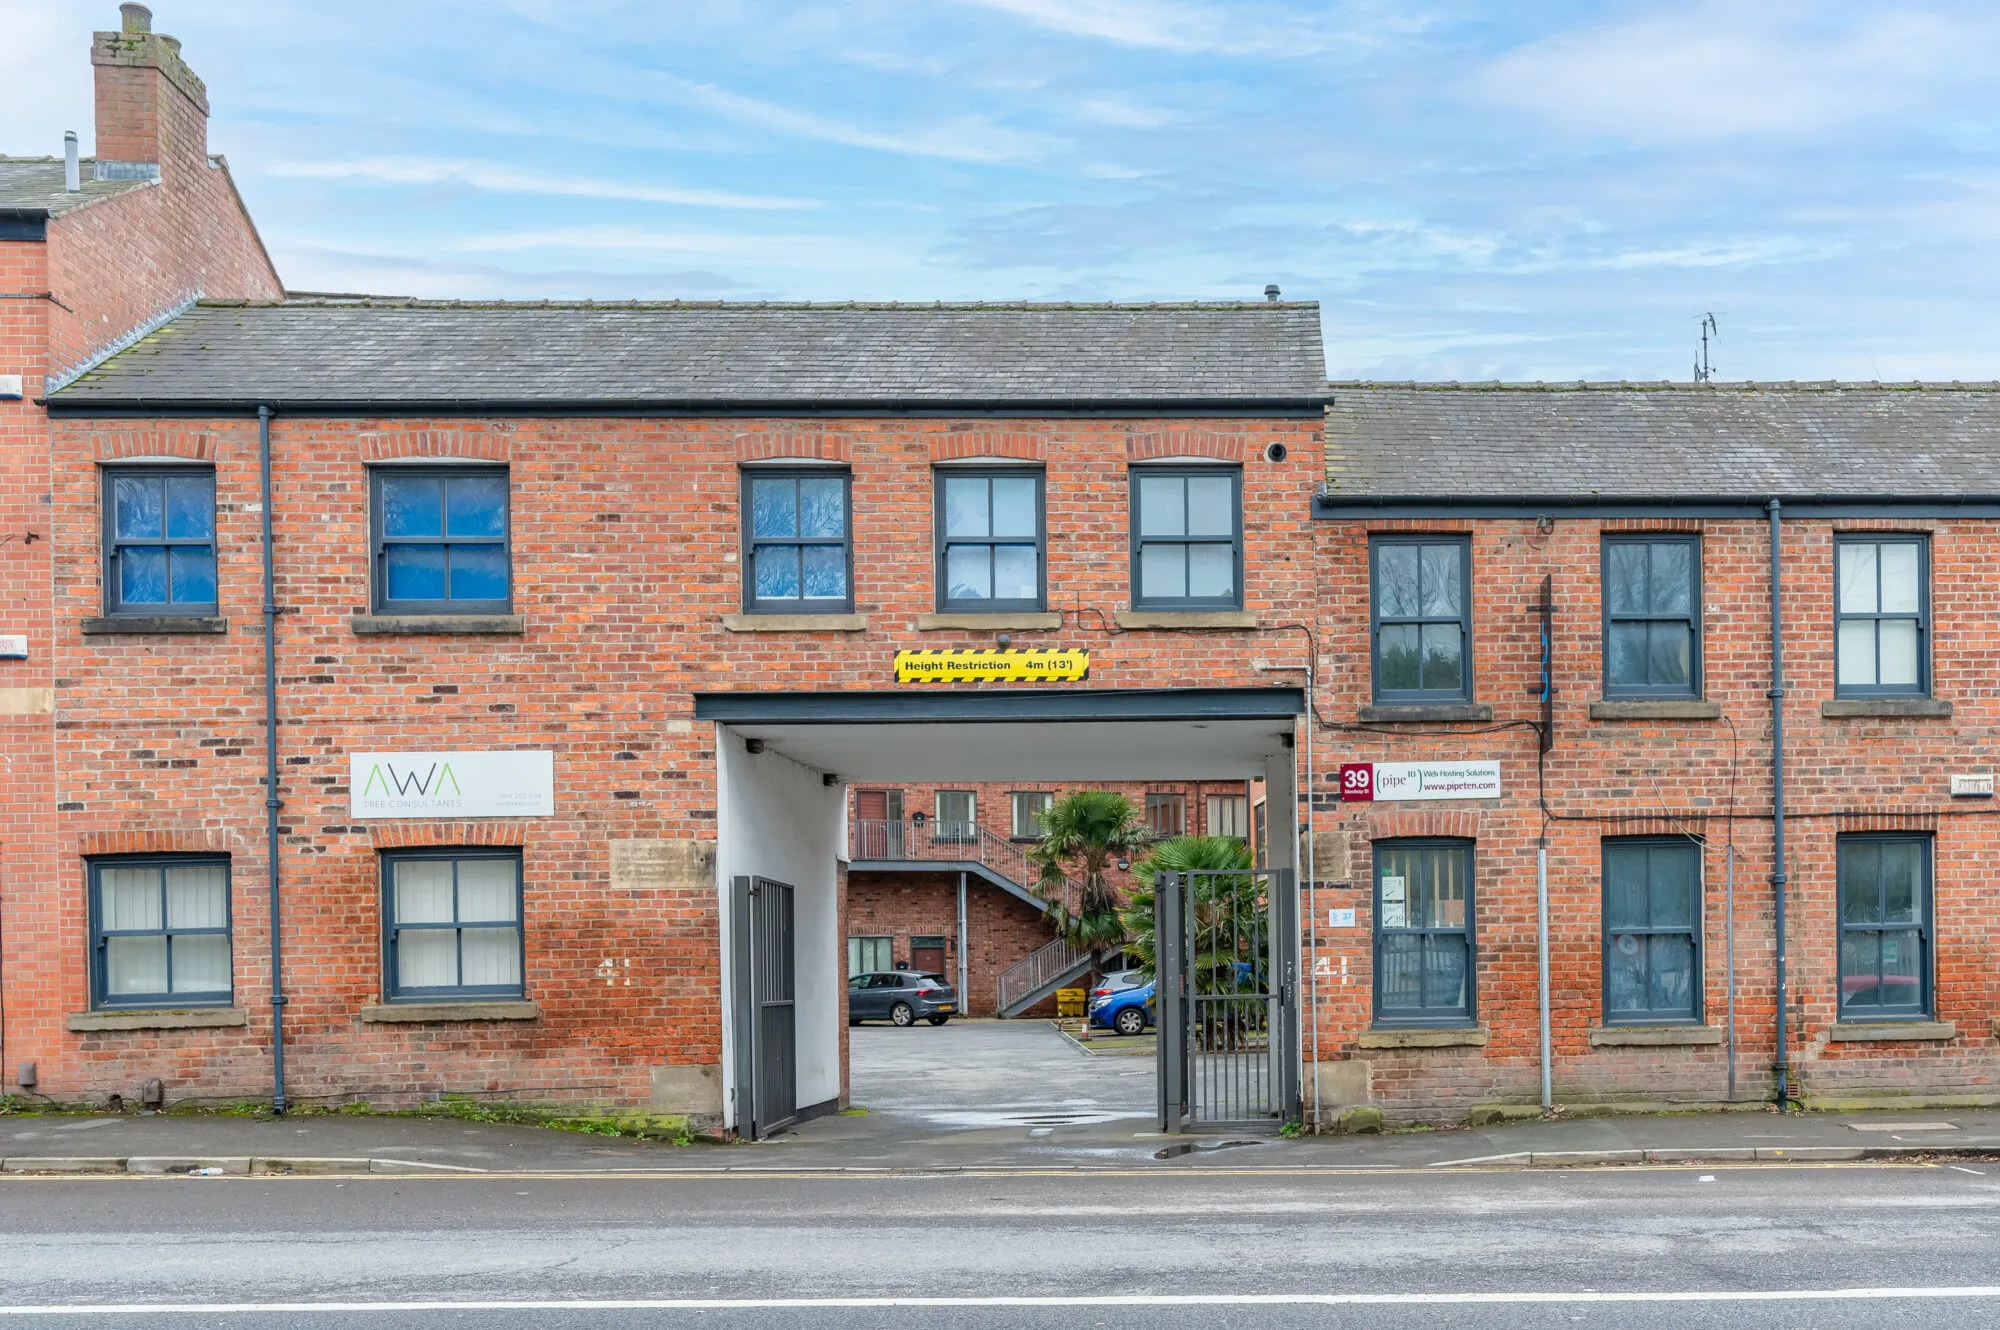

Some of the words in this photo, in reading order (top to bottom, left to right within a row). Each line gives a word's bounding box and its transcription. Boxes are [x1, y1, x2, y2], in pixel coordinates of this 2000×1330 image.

[905, 661, 943, 672] Height
[947, 660, 1011, 670] Restriction
[1025, 661, 1044, 669] 4m
[1345, 769, 1369, 788] 39
[1440, 769, 1464, 778] Hosting
[1466, 768, 1496, 777] Solutions
[363, 762, 461, 797] AWA
[1424, 782, 1496, 792] www.pipeten.com
[363, 800, 386, 809] TREE
[388, 799, 462, 809] CONSULTANTS
